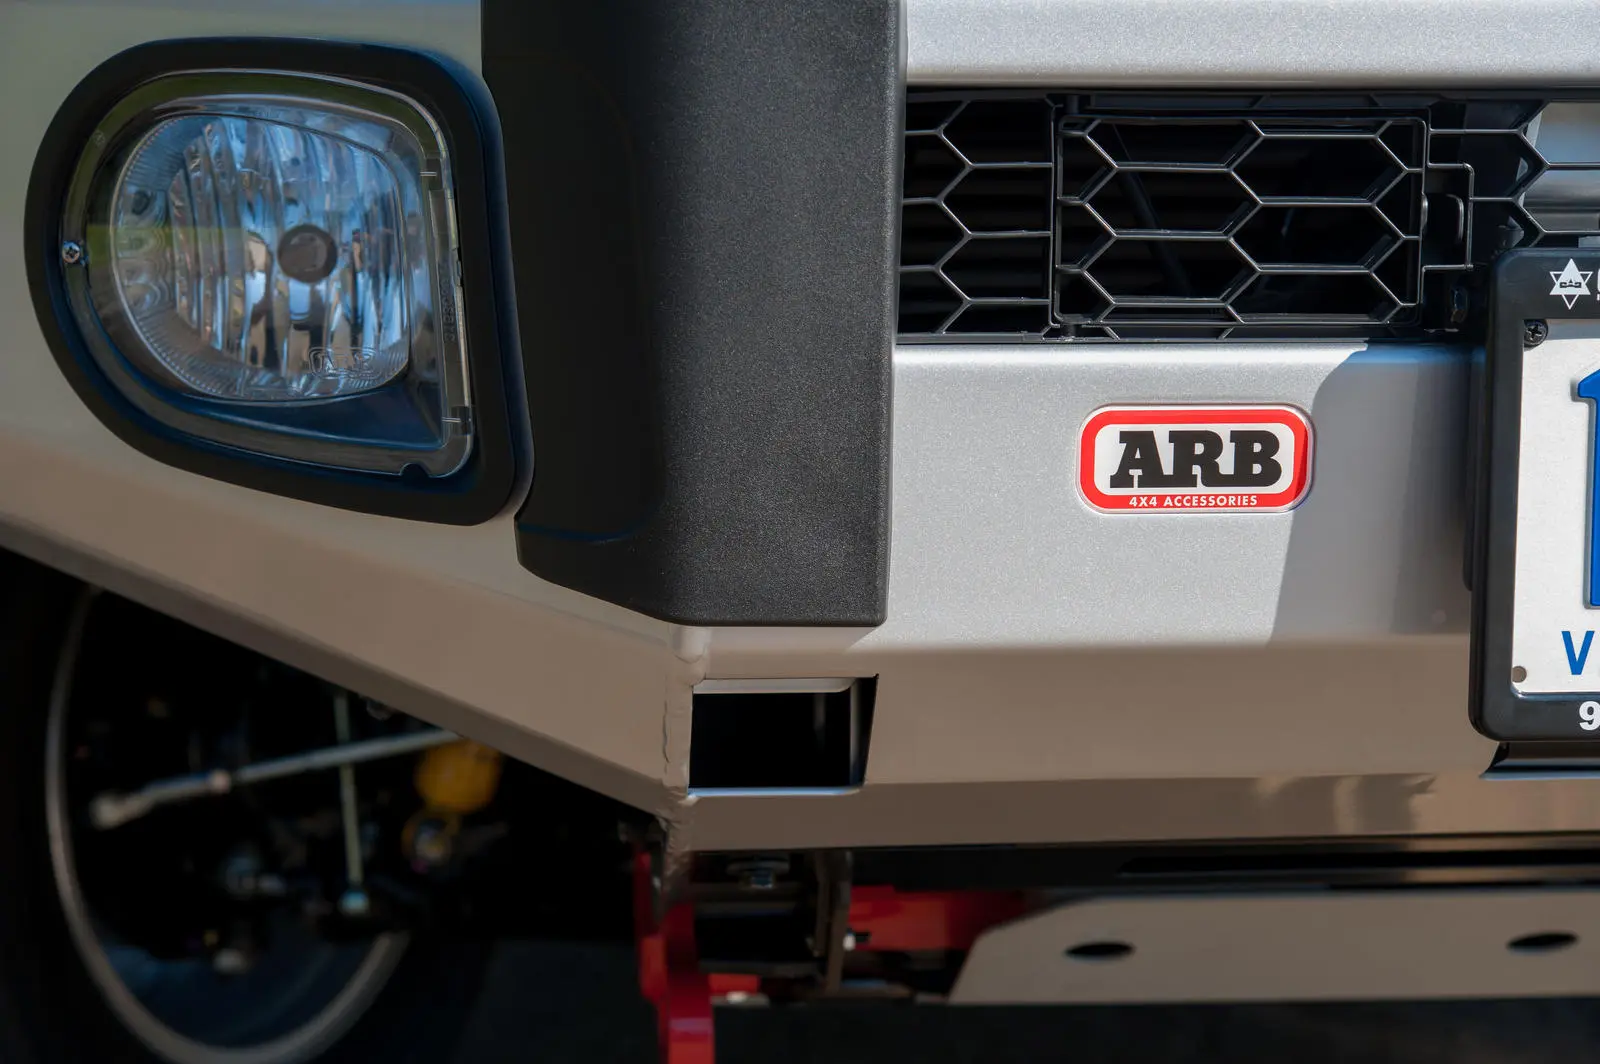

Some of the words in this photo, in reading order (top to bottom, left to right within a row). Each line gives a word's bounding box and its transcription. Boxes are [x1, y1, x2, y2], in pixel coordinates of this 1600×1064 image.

[1110, 430, 1282, 488] ARB
[1129, 496, 1157, 507] 4X4
[1163, 495, 1258, 507] ACCESSORIES
[1561, 630, 1595, 675] V
